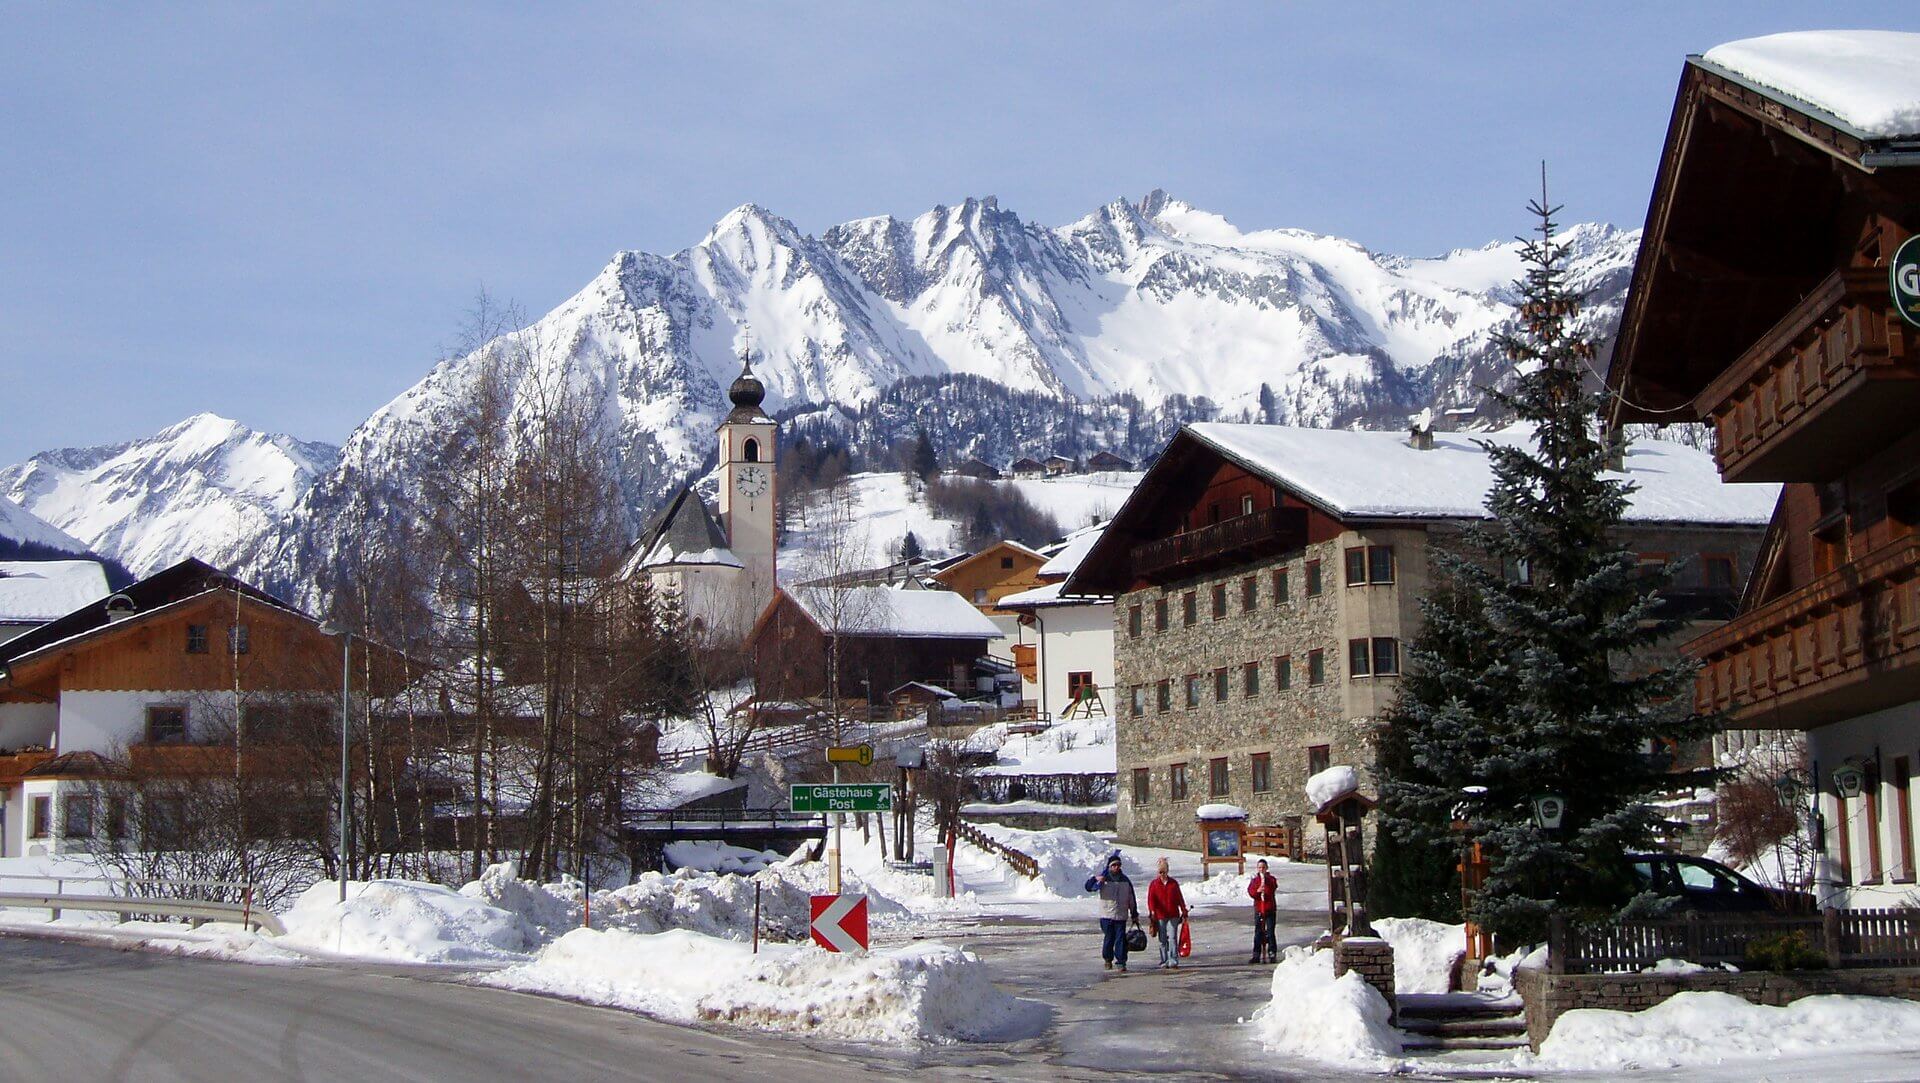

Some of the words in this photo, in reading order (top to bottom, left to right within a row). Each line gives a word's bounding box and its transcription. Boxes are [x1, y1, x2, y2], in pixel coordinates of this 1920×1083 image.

[860, 748, 869, 761] H
[813, 787, 873, 798] Gästehaus
[829, 799, 855, 809] Post
